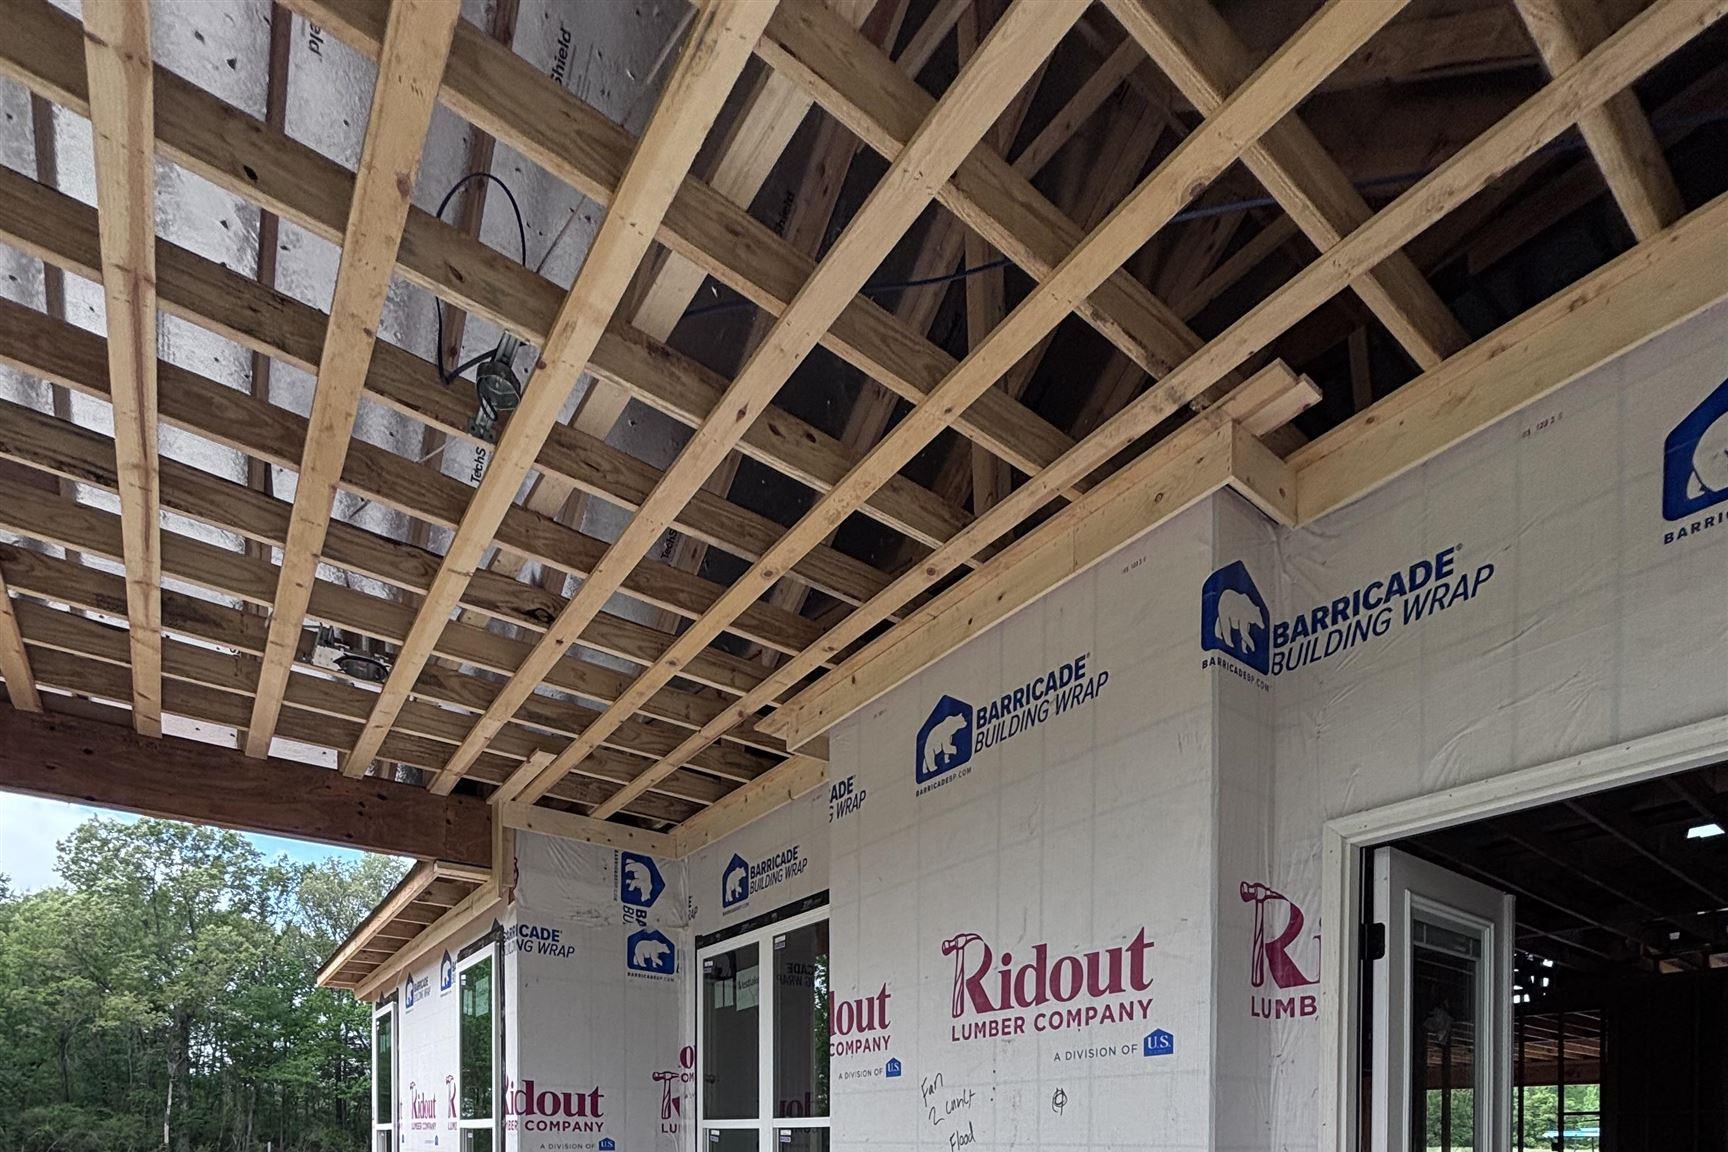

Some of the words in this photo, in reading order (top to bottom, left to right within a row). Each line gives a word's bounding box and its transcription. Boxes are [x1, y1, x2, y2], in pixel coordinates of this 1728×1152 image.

[1272, 607, 1392, 676] BUILDING
[1401, 563, 1495, 626] WRAP
[974, 699, 1050, 754] BUILDING
[1055, 670, 1109, 717] WRAP
[915, 766, 972, 798] BARRICADEBP.COM
[836, 790, 867, 819] WRAP
[749, 869, 783, 895] BUILDING
[785, 857, 808, 880] WRAP
[750, 845, 799, 880] BARRICADE
[538, 941, 576, 958] WRAP
[942, 927, 1155, 1018] Ridout
[952, 1016, 1026, 1042] LUMBER
[1034, 998, 1153, 1033] COMPANY
[1054, 1052, 1061, 1062] A
[1065, 1046, 1117, 1061] DIVISION
[1121, 1044, 1138, 1056] OF
[845, 1068, 872, 1079] DIVISION
[874, 1067, 883, 1076] OF
[525, 1119, 605, 1132] COMPANY
[929, 1106, 945, 1126] 2
[548, 1142, 583, 1150] DIVISION
[586, 1142, 595, 1150] OF
